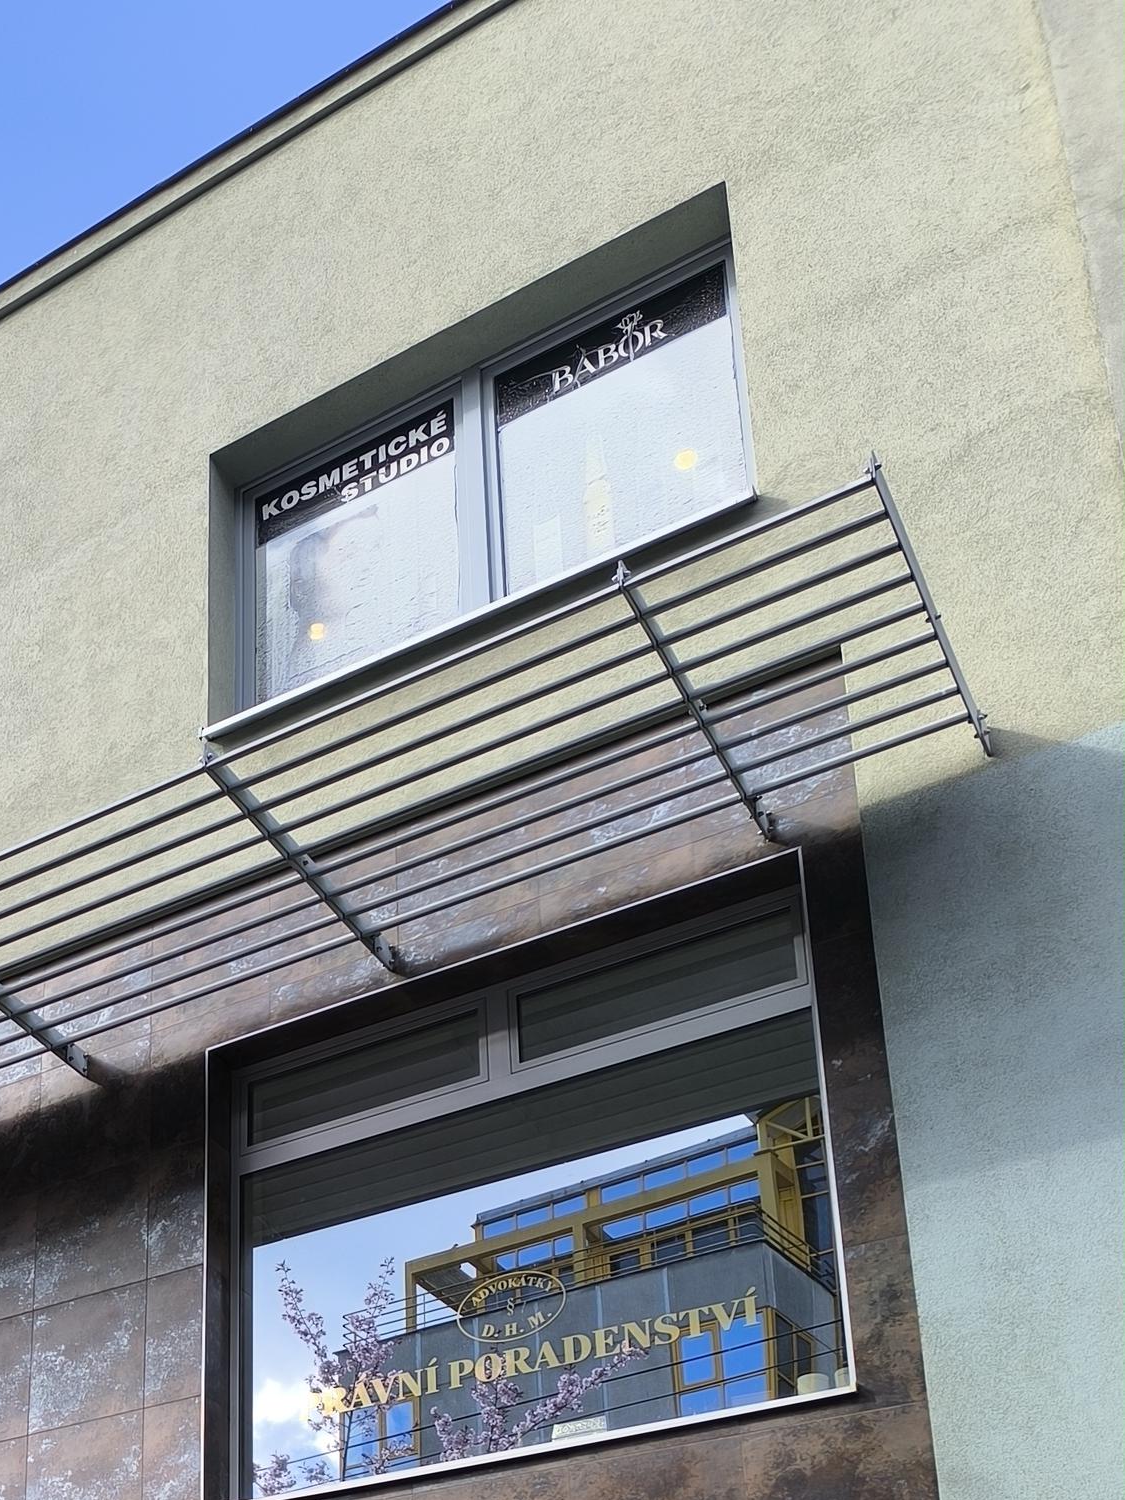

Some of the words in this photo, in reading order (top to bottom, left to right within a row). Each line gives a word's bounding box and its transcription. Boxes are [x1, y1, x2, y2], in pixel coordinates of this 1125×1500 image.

[552, 317, 668, 395] BABOR
[261, 409, 447, 520] KOSMETICKÉ
[341, 437, 450, 503] STUDIO
[471, 1274, 553, 1307] ADVOKÁTKY
[448, 1286, 761, 1389] PORADENSTVÍ
